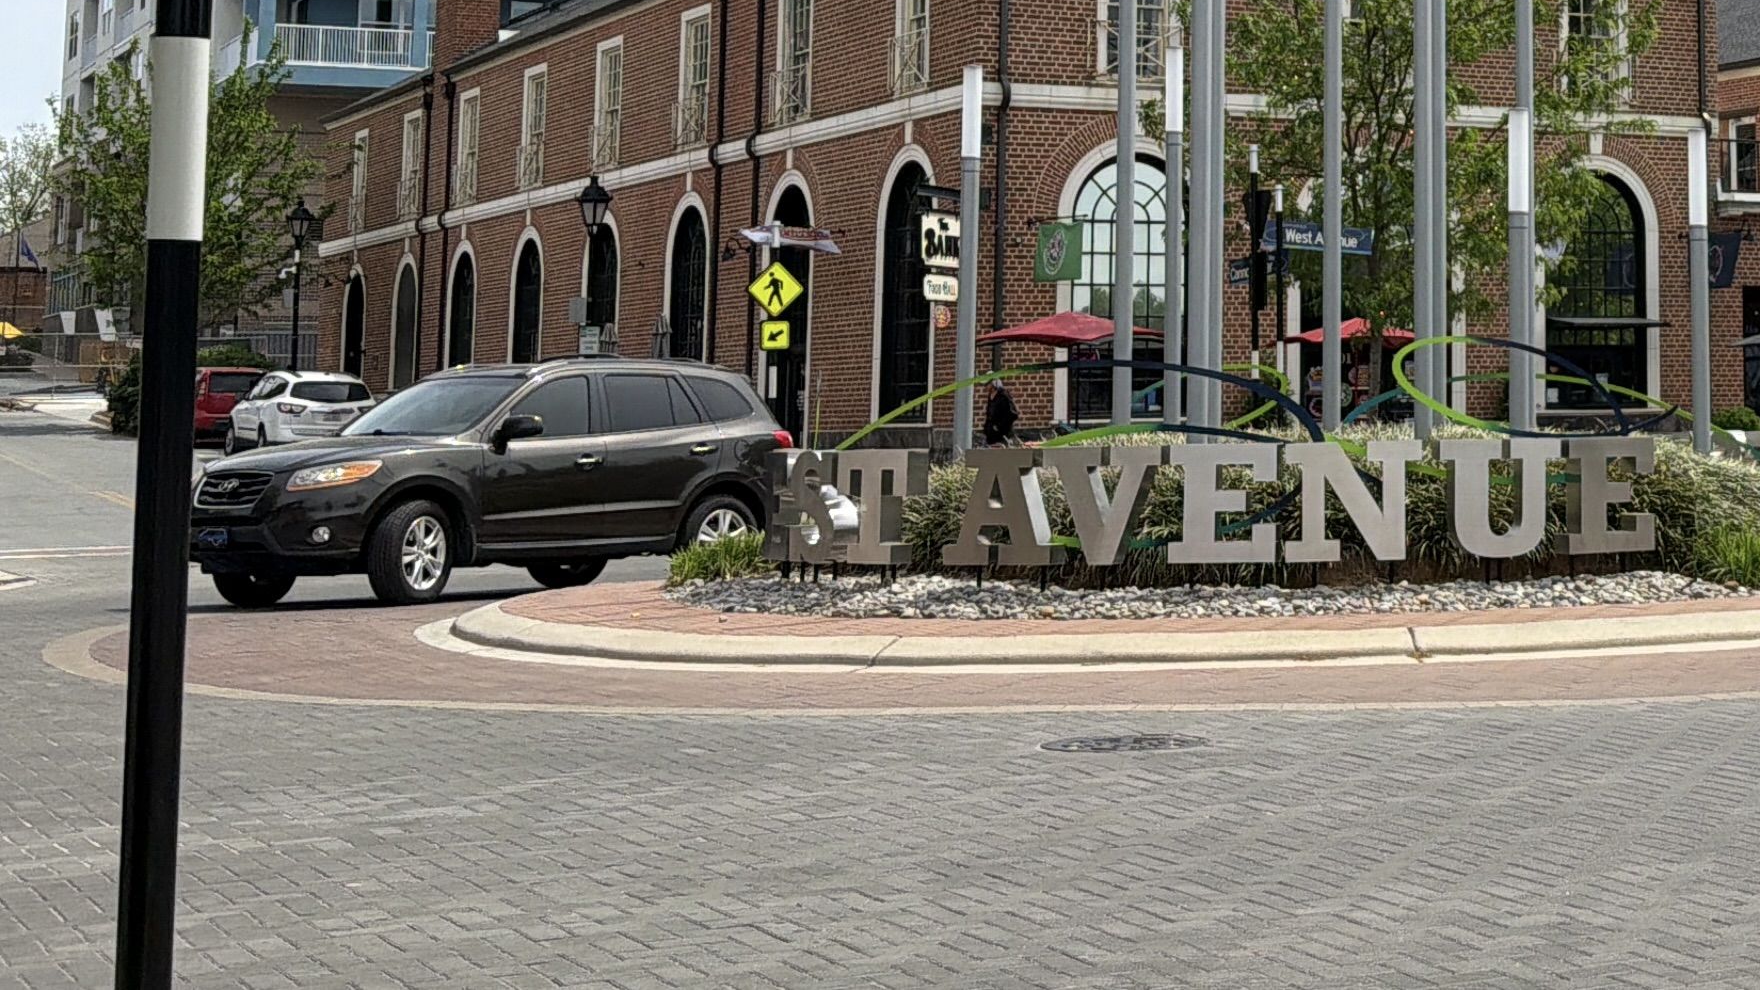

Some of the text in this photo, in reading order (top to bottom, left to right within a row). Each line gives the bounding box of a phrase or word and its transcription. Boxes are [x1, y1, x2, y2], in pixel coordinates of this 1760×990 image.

[1284, 228, 1359, 249] West Anue
[942, 437, 1656, 567] AVENUE
